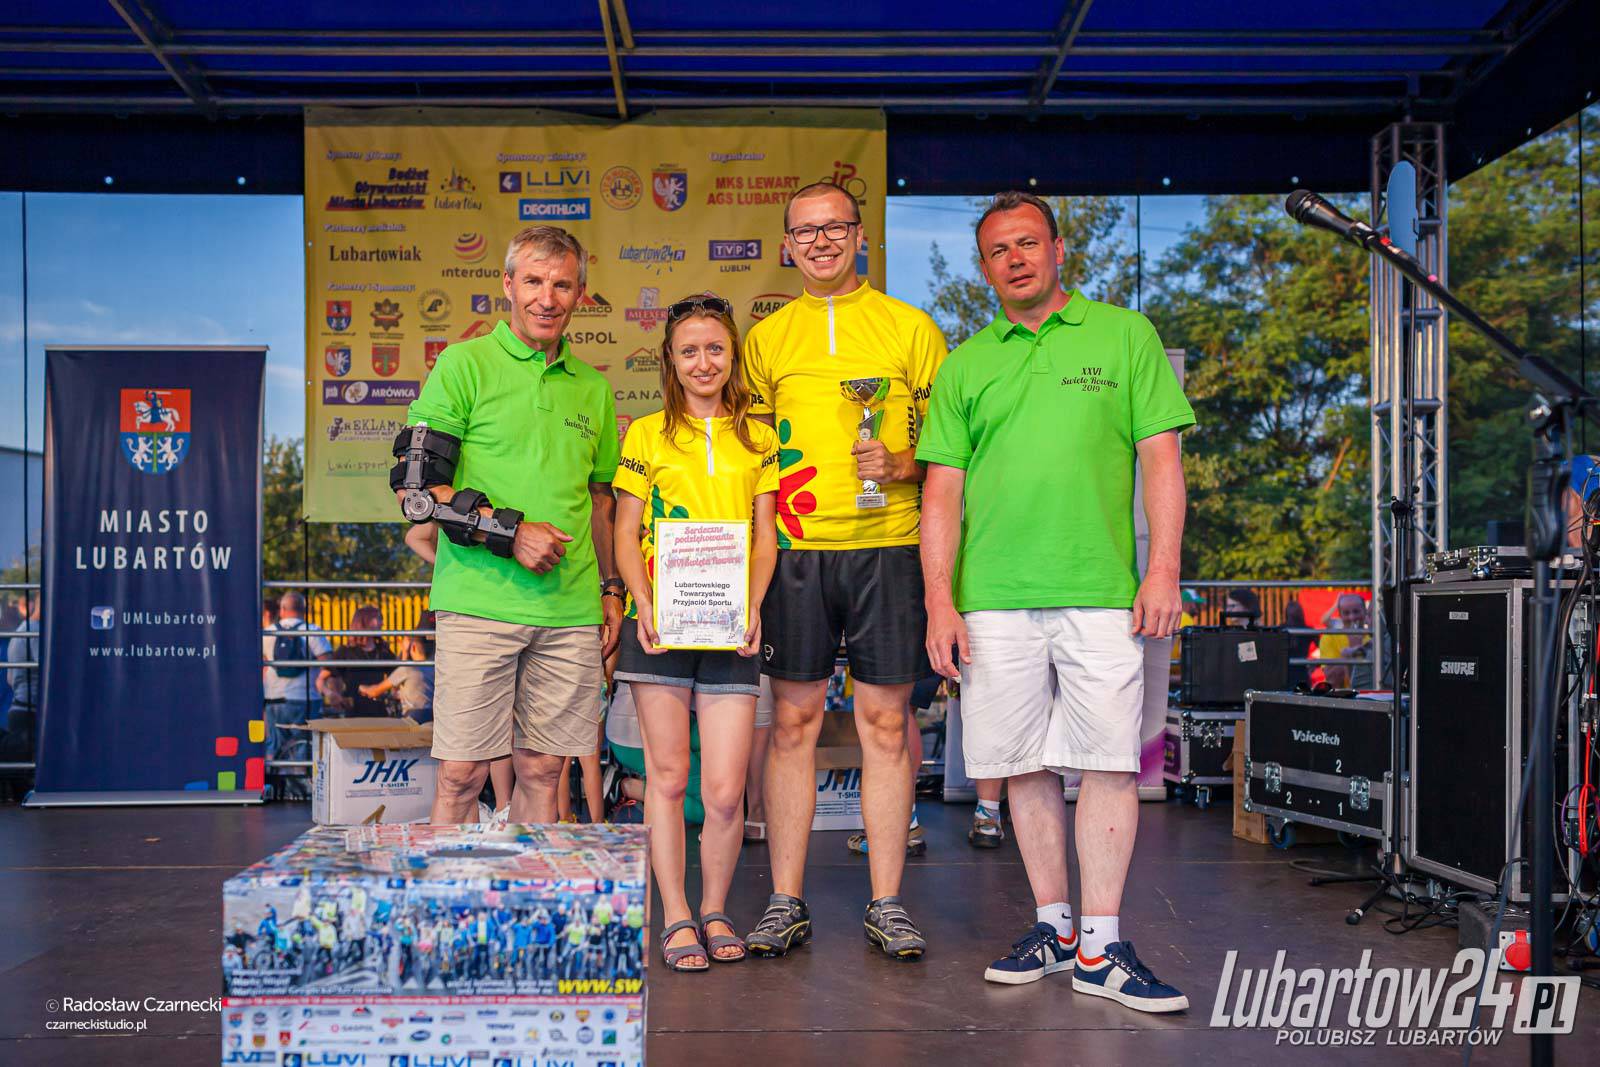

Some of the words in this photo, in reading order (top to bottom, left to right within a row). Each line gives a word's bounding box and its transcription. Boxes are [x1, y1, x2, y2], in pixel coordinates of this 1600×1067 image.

[528, 170, 590, 185] LUVI
[716, 176, 744, 189] MKS
[748, 176, 800, 189] LEWART
[707, 192, 733, 205] AGS
[523, 203, 585, 215] DECATHLON
[329, 245, 422, 261] Lubartowiak
[715, 244, 743, 257] TVP
[747, 242, 758, 256] 3
[441, 268, 500, 278] interduo
[720, 264, 751, 272] LUBLIN
[1081, 367, 1102, 376] XXVI
[371, 387, 416, 398] MRÓWKA
[1081, 384, 1101, 392] 2019
[99, 509, 209, 534] MIASTO
[75, 541, 231, 571] LUBARTÓW
[674, 581, 731, 590] Lubartowskiego
[679, 590, 726, 598] Towarzystwa
[672, 598, 707, 607] Przyjaciół
[708, 599, 732, 607] Sportu
[123, 612, 217, 625] UMLubartow
[89, 644, 217, 660] www.lubartow.pl
[1440, 661, 1476, 676] SHURE
[1291, 729, 1340, 747] VoiceTech
[352, 758, 420, 784] JHK
[1335, 759, 1342, 773] 2
[1286, 791, 1292, 804] 2
[1338, 802, 1343, 816] 1
[557, 978, 643, 995] www.sw
